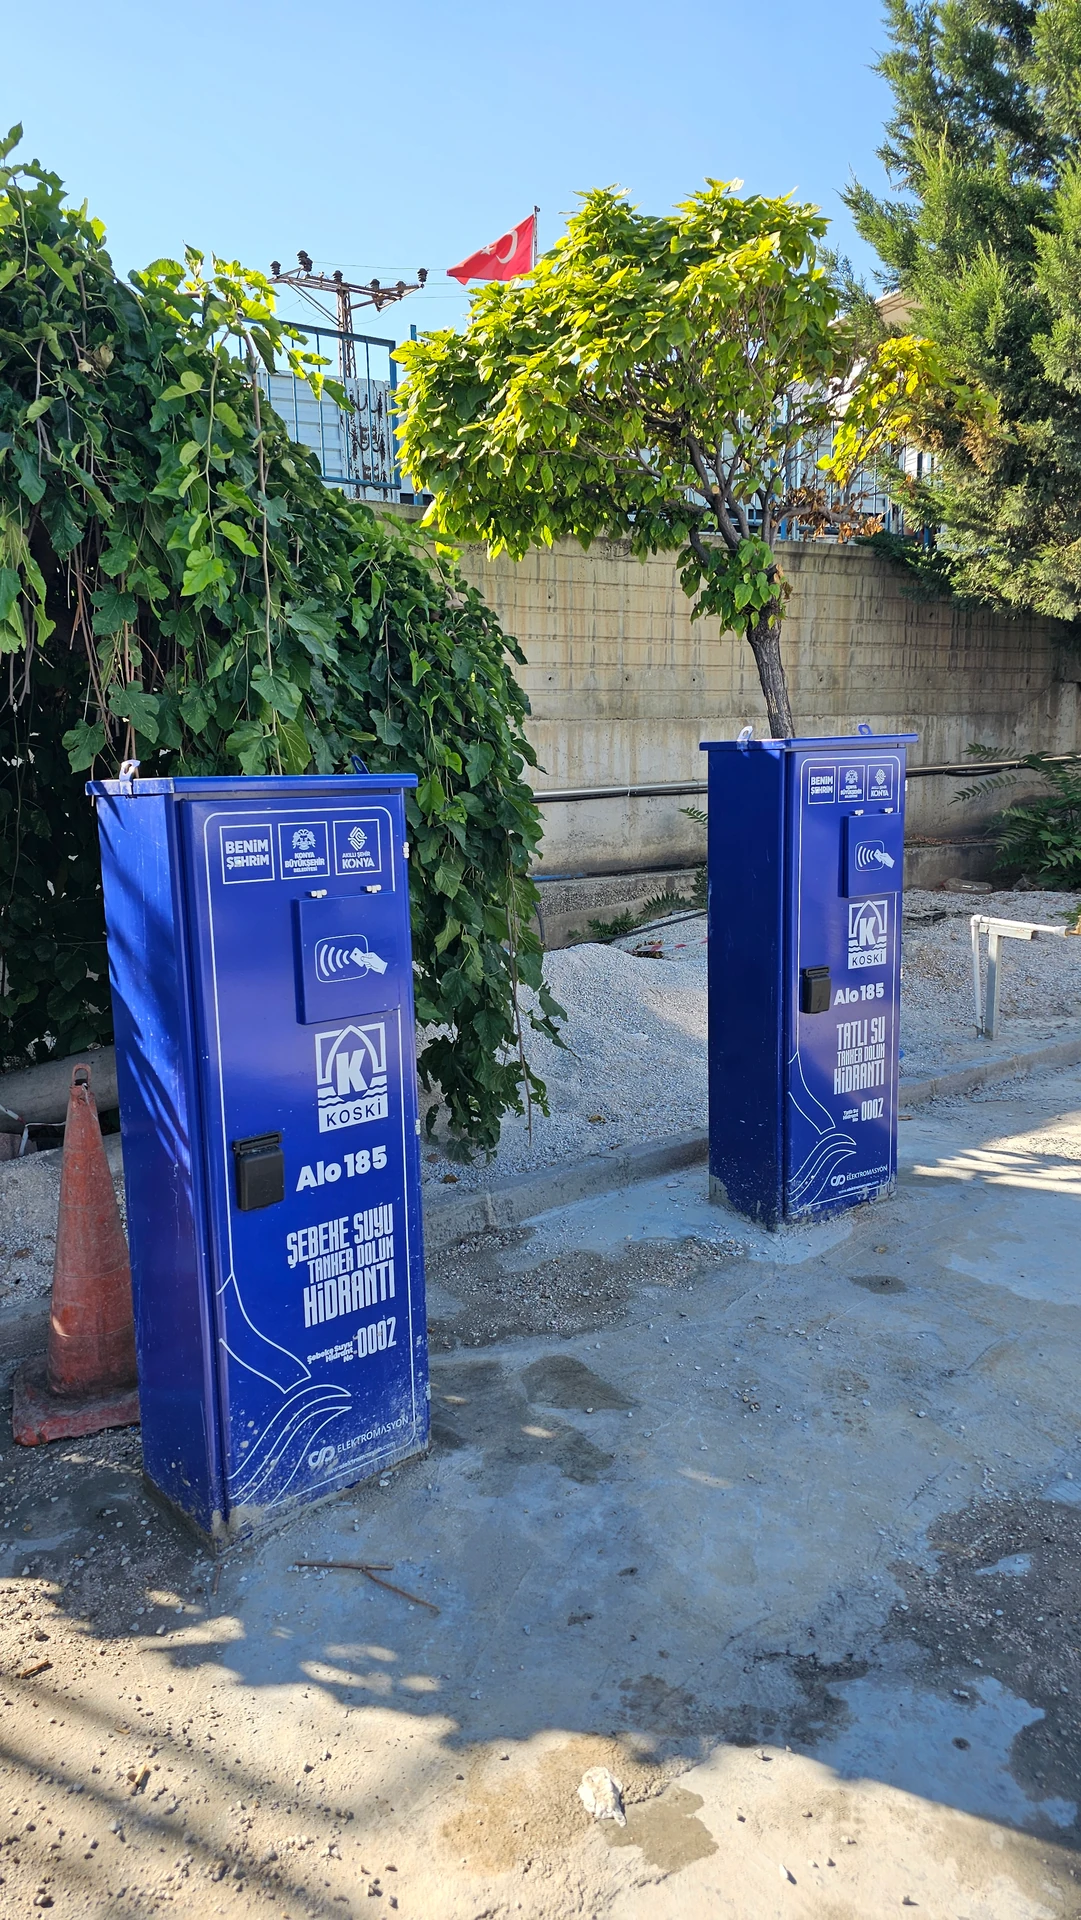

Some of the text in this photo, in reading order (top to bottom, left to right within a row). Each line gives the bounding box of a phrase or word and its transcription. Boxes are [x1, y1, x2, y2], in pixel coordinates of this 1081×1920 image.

[811, 776, 833, 785] BENİM
[225, 839, 269, 854] BENİM
[342, 857, 375, 869] KONYA
[852, 950, 883, 966] KOSKİ
[833, 982, 884, 1006] Alo 185
[836, 1016, 886, 1051] TATLI SU
[833, 1059, 885, 1095] HİDRANTI
[326, 1098, 382, 1127] KOSKİ
[861, 1097, 884, 1121] 0002
[296, 1145, 388, 1192] Alo 185
[286, 1203, 394, 1269] ŞEBEKE SUYU
[307, 1235, 394, 1284] TANKER DOLUM
[303, 1259, 395, 1328] HİDRANTI
[357, 1316, 397, 1358] 0002
[337, 1415, 409, 1453] ELEKTROMASYON
